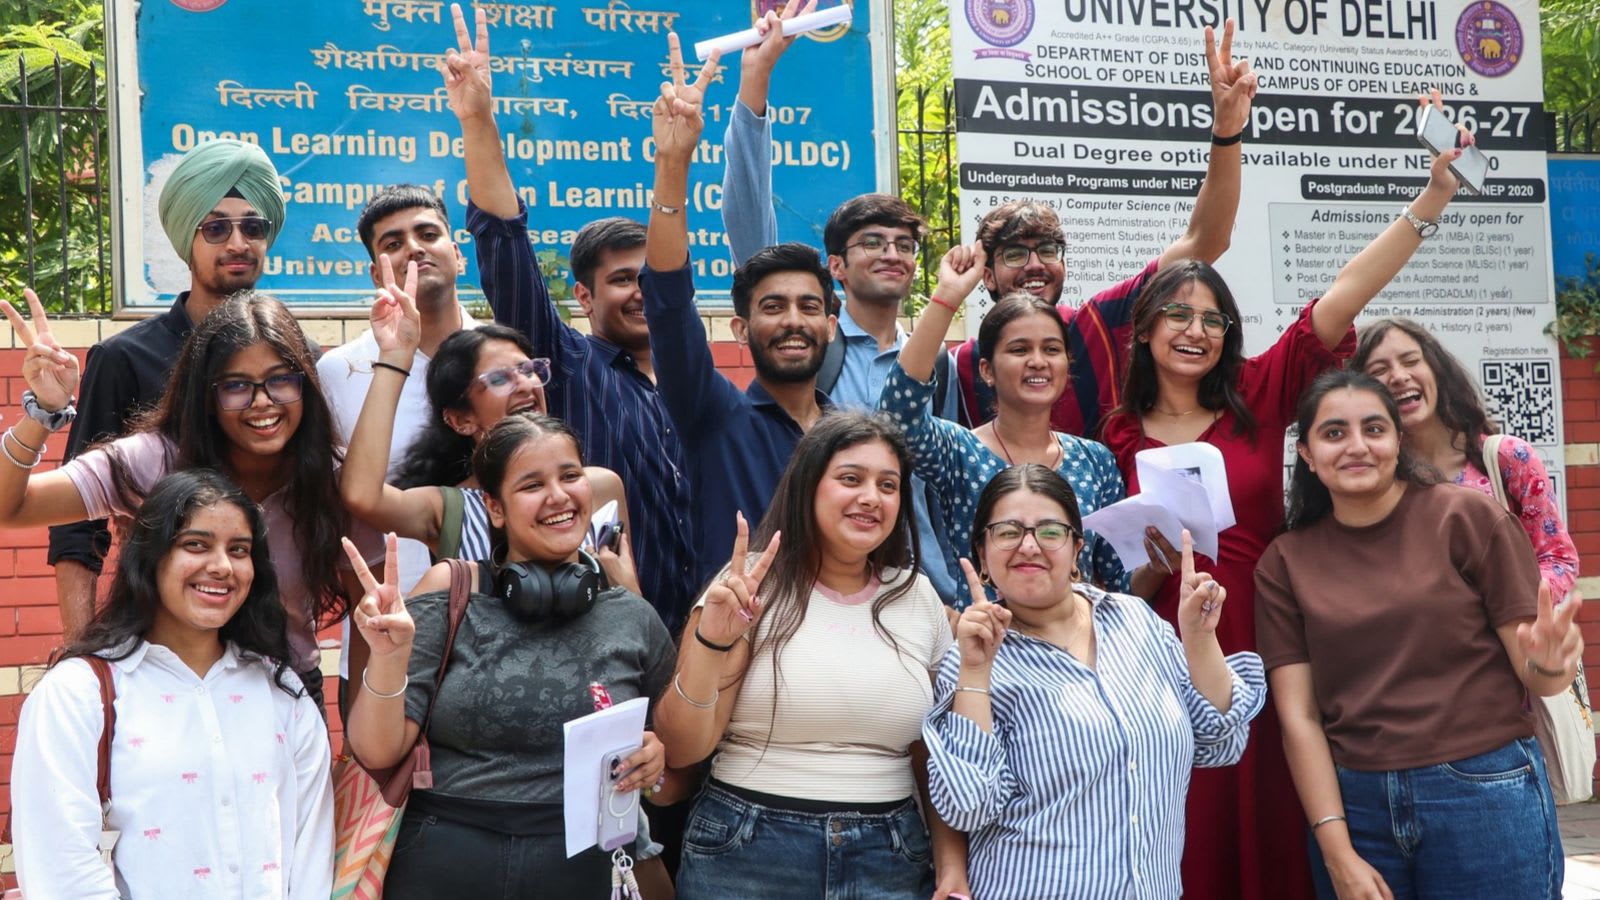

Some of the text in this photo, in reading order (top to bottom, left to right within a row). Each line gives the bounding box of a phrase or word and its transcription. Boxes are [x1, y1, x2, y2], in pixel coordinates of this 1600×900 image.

[581, 0, 680, 33] परिसर
[1284, 0, 1328, 35] OF
[1342, 0, 1437, 40] DELHI
[1051, 30, 1094, 41] Accredited
[1096, 31, 1112, 41] A++
[1115, 33, 1140, 43] Grade
[1143, 34, 1170, 45] (CGPA
[1193, 37, 1201, 46] in
[1244, 40, 1254, 51] by
[1283, 42, 1319, 54] Category
[1319, 44, 1359, 56] (University
[1361, 46, 1384, 55] Status
[1386, 47, 1419, 57] Awarded
[1430, 48, 1452, 59] UGC)
[1037, 45, 1144, 64] DEPARTMENT
[1148, 51, 1169, 65] OF
[1253, 57, 1285, 70] AND
[1289, 58, 1380, 75] CONTINUING
[1384, 62, 1466, 77] EDUCATION
[1024, 64, 1092, 80] SCHOOL
[1096, 67, 1117, 81] OF
[1122, 69, 1165, 84] OPEN
[1257, 75, 1319, 91] CAMPUS
[1324, 78, 1343, 92] OF
[1348, 79, 1388, 93] OPEN
[1393, 81, 1465, 96] LEARNING
[1469, 83, 1479, 96] &
[215, 80, 319, 110] दिल्ली
[972, 85, 1214, 129] Admissions
[1243, 104, 1320, 138] pen
[1330, 102, 1384, 134] for
[272, 126, 417, 163] Learning
[429, 131, 632, 166] Delopment
[1013, 141, 1065, 159] Dual
[1073, 144, 1153, 164] Degree
[1241, 151, 1330, 168] available
[1337, 152, 1398, 169] under
[1405, 155, 1431, 170] NE
[968, 170, 1064, 187] Undergraduate
[1067, 174, 1129, 190] Programs
[1132, 177, 1168, 190] under
[1171, 178, 1198, 190] NEP
[1308, 181, 1385, 196] Postgraduate
[1481, 184, 1505, 196] NEP
[1507, 184, 1534, 197] 2020
[1066, 198, 1123, 212] Computer
[1126, 199, 1171, 212] Science
[1097, 216, 1166, 229] Administration
[1311, 209, 1390, 223] Admissions
[1470, 214, 1502, 227] open
[1505, 211, 1524, 224] for
[1118, 230, 1154, 241] Studies
[1156, 232, 1166, 243] (4
[1294, 230, 1325, 240] Master
[1328, 230, 1336, 240] in
[1339, 230, 1380, 241] Business
[1446, 231, 1474, 242] (MBA)
[1475, 232, 1485, 242] (2
[1487, 232, 1514, 243] years)
[1066, 244, 1164, 258] Economics (4 years)
[1295, 243, 1332, 254] Bachelor
[1333, 244, 1342, 254] of
[1440, 245, 1470, 255] Science
[1513, 246, 1534, 257] year)
[1066, 258, 1103, 270] English
[1105, 259, 1115, 270] (4
[1296, 258, 1325, 269] Master
[1327, 259, 1335, 269] of
[1432, 259, 1463, 270] Science
[1508, 260, 1529, 272] year)
[1067, 271, 1105, 281] Political
[1297, 273, 1318, 283] Post
[1403, 274, 1411, 283] in
[1413, 274, 1461, 283] Automated
[1463, 274, 1479, 283] and
[1490, 289, 1513, 301] year)
[1363, 306, 1536, 318] Health Care Administration (2 years) (New)
[1441, 322, 1472, 334] History
[1474, 323, 1484, 333] (2
[1485, 323, 1512, 335] years)
[1483, 346, 1549, 355] Registration here
